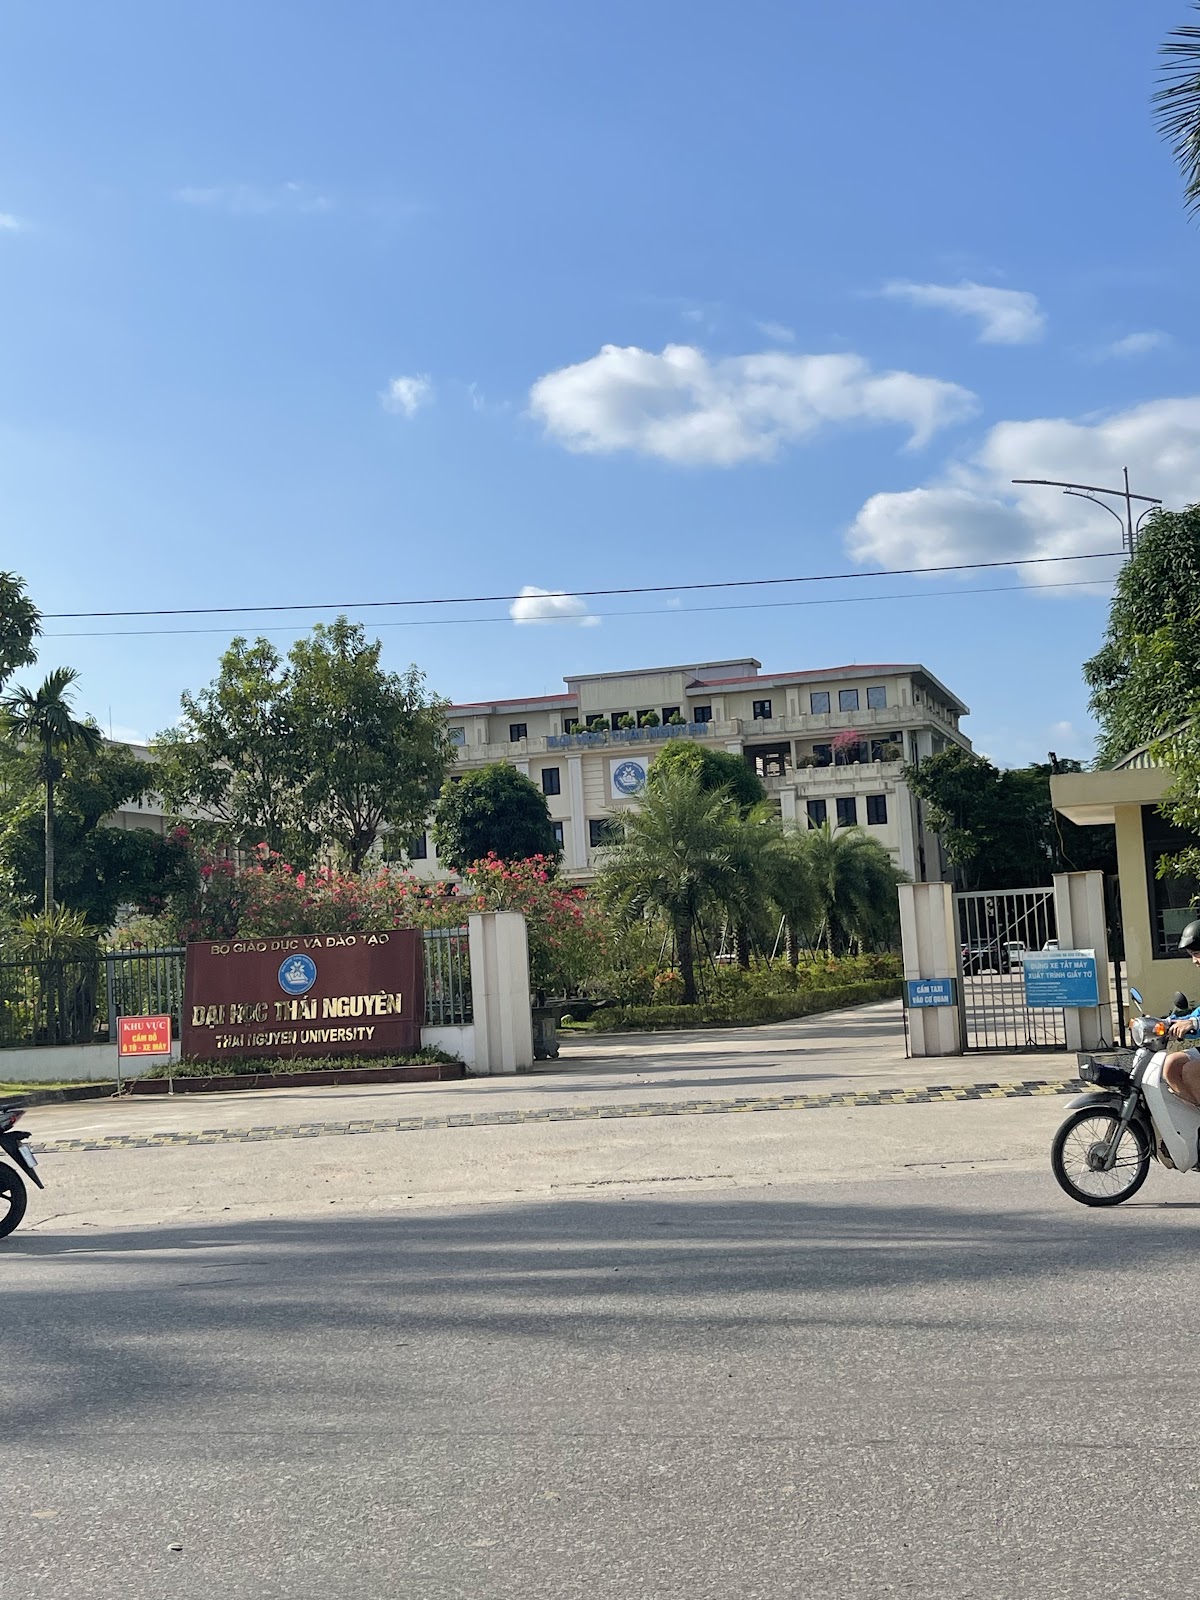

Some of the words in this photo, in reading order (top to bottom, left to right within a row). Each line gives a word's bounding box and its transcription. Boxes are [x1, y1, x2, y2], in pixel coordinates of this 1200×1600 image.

[271, 940, 299, 953] DỤC
[303, 936, 322, 949] VÀ
[326, 934, 357, 947] ĐÀO
[1074, 960, 1088, 968] MÁY
[916, 984, 930, 994] CẤM
[912, 995, 924, 1004] VÀO
[933, 995, 949, 1003] QUAN
[192, 1004, 225, 1029] ĐẠI
[229, 1001, 268, 1027] HỌC
[274, 995, 317, 1023] THÁI
[322, 990, 402, 1019] NGUYÊN
[124, 1022, 144, 1030] KHU
[146, 1020, 166, 1031] VỰC
[132, 1032, 147, 1042] CẤM
[215, 1035, 244, 1049] THAI
[247, 1031, 297, 1047] NGUYEN
[300, 1026, 375, 1044] UNIVERSITY
[122, 1044, 128, 1052] Ô
[128, 1043, 137, 1052] TÔ
[152, 1042, 167, 1050] MÁY
